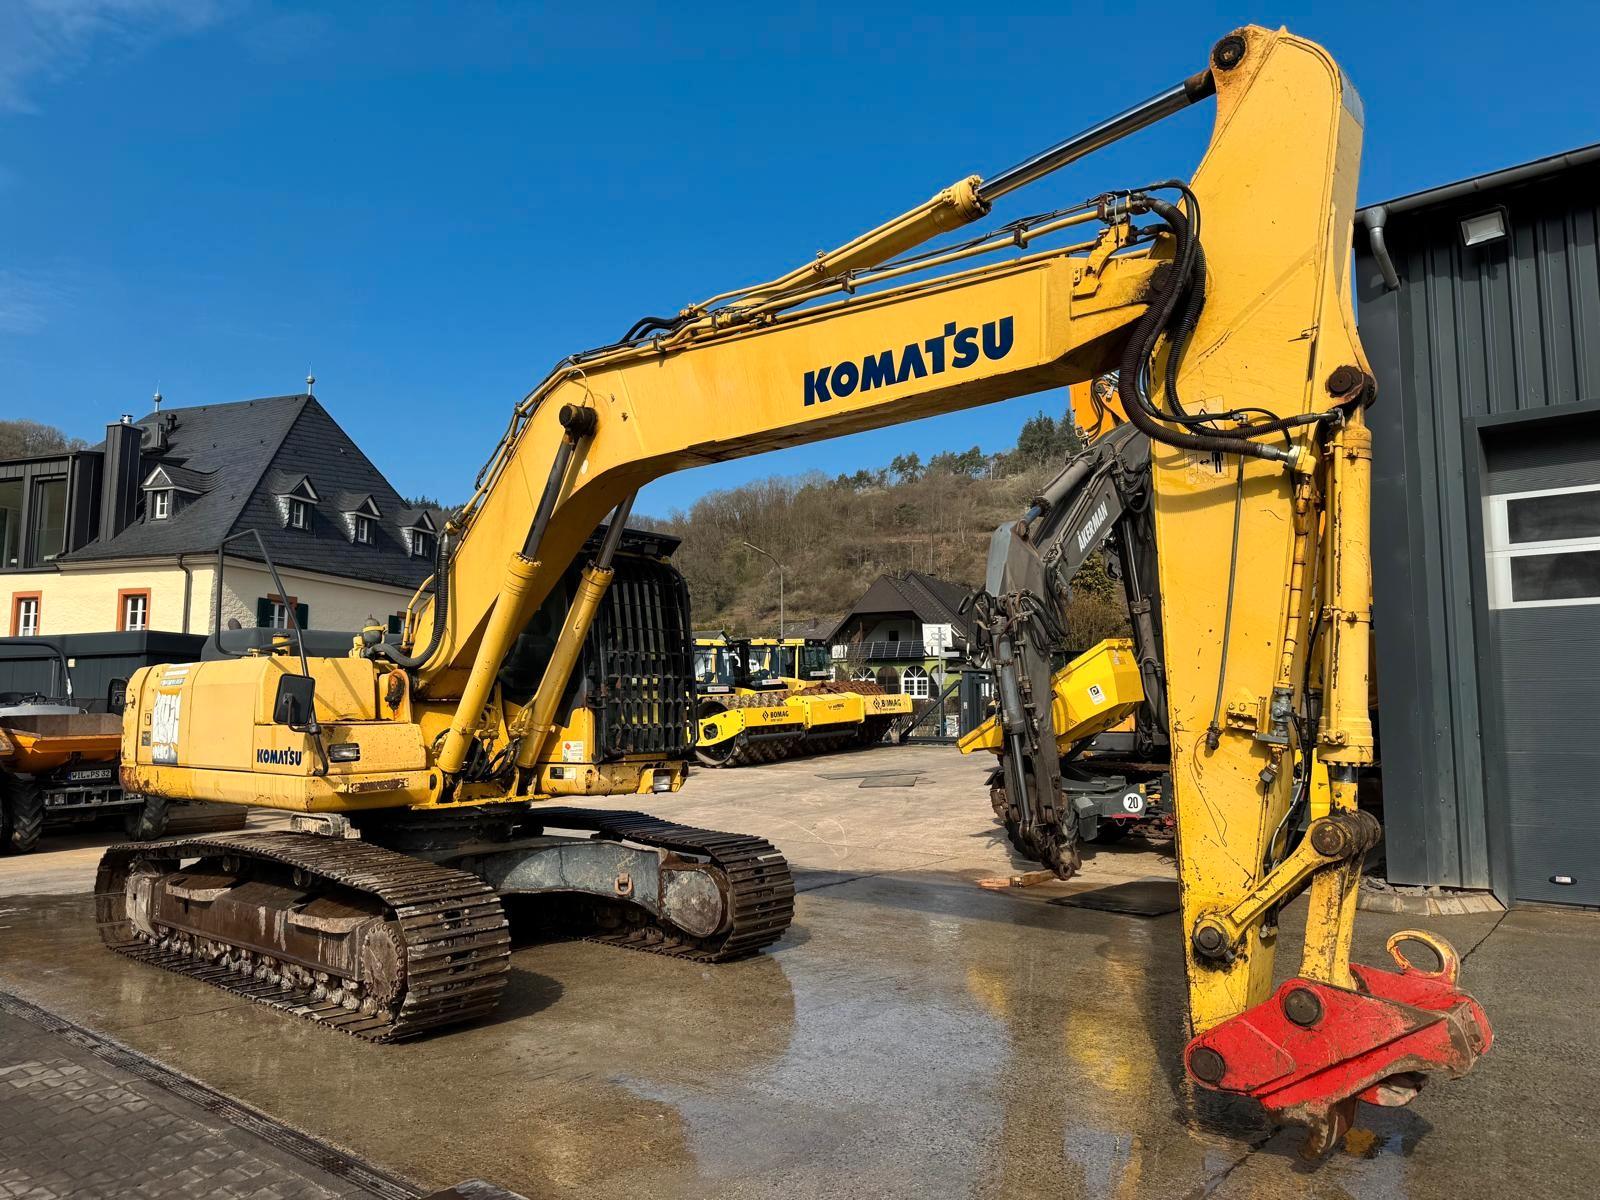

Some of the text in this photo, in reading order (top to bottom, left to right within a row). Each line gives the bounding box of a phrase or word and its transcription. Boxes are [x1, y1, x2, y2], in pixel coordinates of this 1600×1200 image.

[803, 315, 1014, 407] KOMATSU
[1076, 500, 1108, 553] ÅKERMAN
[770, 710, 789, 719] BOMAG
[256, 746, 302, 766] KOMATSU
[1127, 796, 1139, 809] 20
